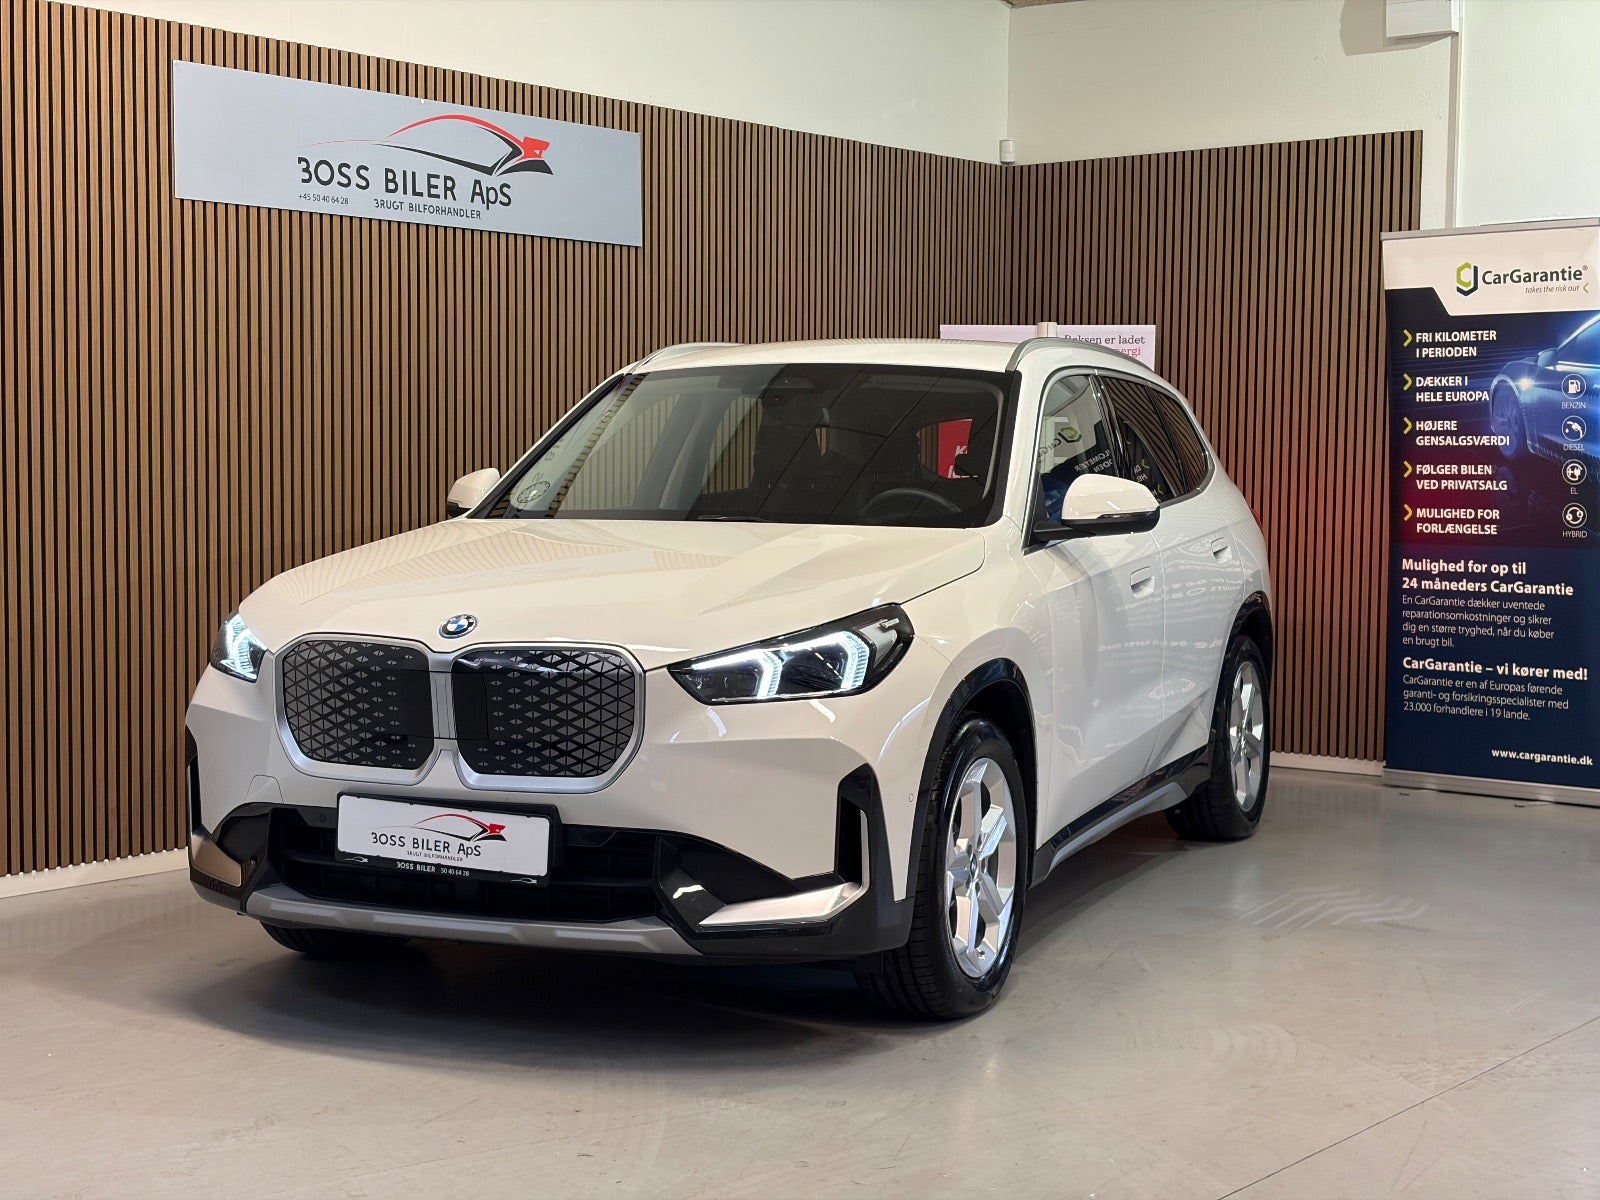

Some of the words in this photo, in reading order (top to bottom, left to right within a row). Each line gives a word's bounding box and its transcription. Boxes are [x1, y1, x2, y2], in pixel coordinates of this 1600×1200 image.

[384, 168, 456, 201] BILER
[470, 178, 512, 210] ApS
[312, 194, 320, 202] 50
[322, 195, 330, 203] 40
[408, 203, 481, 220] BILFORHANDLER
[1119, 335, 1145, 344] ladet
[1416, 332, 1432, 343] FRI
[1434, 330, 1497, 342] KILOMETER
[1416, 348, 1420, 358] I
[1422, 346, 1477, 358] PERIODEN
[1416, 376, 1463, 387] DÆKKER
[1465, 376, 1468, 386] I
[1416, 392, 1443, 402] HELE
[1445, 390, 1490, 402] EUROPA
[1416, 420, 1458, 431] HØJERE
[1416, 435, 1510, 446] GENSALGSVÆRDI
[1416, 464, 1458, 475] FØLGER
[1460, 464, 1492, 475] BILEN
[1416, 480, 1439, 490] VED
[1441, 480, 1508, 491] PRIVATSALG
[1416, 508, 1475, 519] MULIGHED
[1478, 509, 1500, 519] FOR
[1416, 523, 1498, 534] FORLÆNGELSE
[1562, 530, 1587, 538] HYBRID
[1402, 558, 1464, 574] Mulighed
[1468, 560, 1487, 572] for
[1491, 564, 1508, 576] op
[1512, 561, 1526, 574] til
[1402, 577, 1418, 589] 24
[1422, 577, 1487, 592] måneders
[1490, 581, 1574, 596] CarGarantie
[1402, 595, 1413, 605] En
[1414, 596, 1465, 607] CarGarantie
[1467, 598, 1500, 608] dækker
[1502, 600, 1545, 610] uventede
[1402, 610, 1511, 624] reparationsomkostninger
[1513, 616, 1526, 625] og
[1528, 615, 1552, 625] sikrer
[1402, 623, 1416, 633] dig
[1418, 625, 1430, 633] en
[1431, 624, 1456, 634] større
[1458, 625, 1495, 637] tryghed,
[1497, 627, 1511, 637] når
[1514, 628, 1526, 638] du
[1528, 629, 1555, 639] køber
[1402, 637, 1413, 645] en
[1415, 636, 1439, 648] brugt
[1441, 637, 1454, 647] bil.
[1403, 657, 1482, 674] CarGarantie
[1496, 663, 1509, 675] vi
[1512, 664, 1549, 678] kører
[1552, 668, 1588, 680] med!
[1403, 675, 1453, 687] CarGarantie
[1479, 680, 1488, 689] af
[1490, 681, 1525, 693] Europas
[1527, 683, 1563, 695] førende
[1403, 689, 1436, 700] garanti-
[1438, 692, 1450, 702] og
[1452, 691, 1546, 707] forsikringsspecialister
[1548, 699, 1569, 709] med
[1403, 702, 1431, 712] 23.000
[1433, 703, 1483, 716] forhandlere
[1491, 708, 1502, 717] 19
[1503, 709, 1530, 720] lande.
[1492, 749, 1593, 766] www.cargarantie.dk
[412, 838, 450, 853] BILER
[457, 843, 481, 858] ApS
